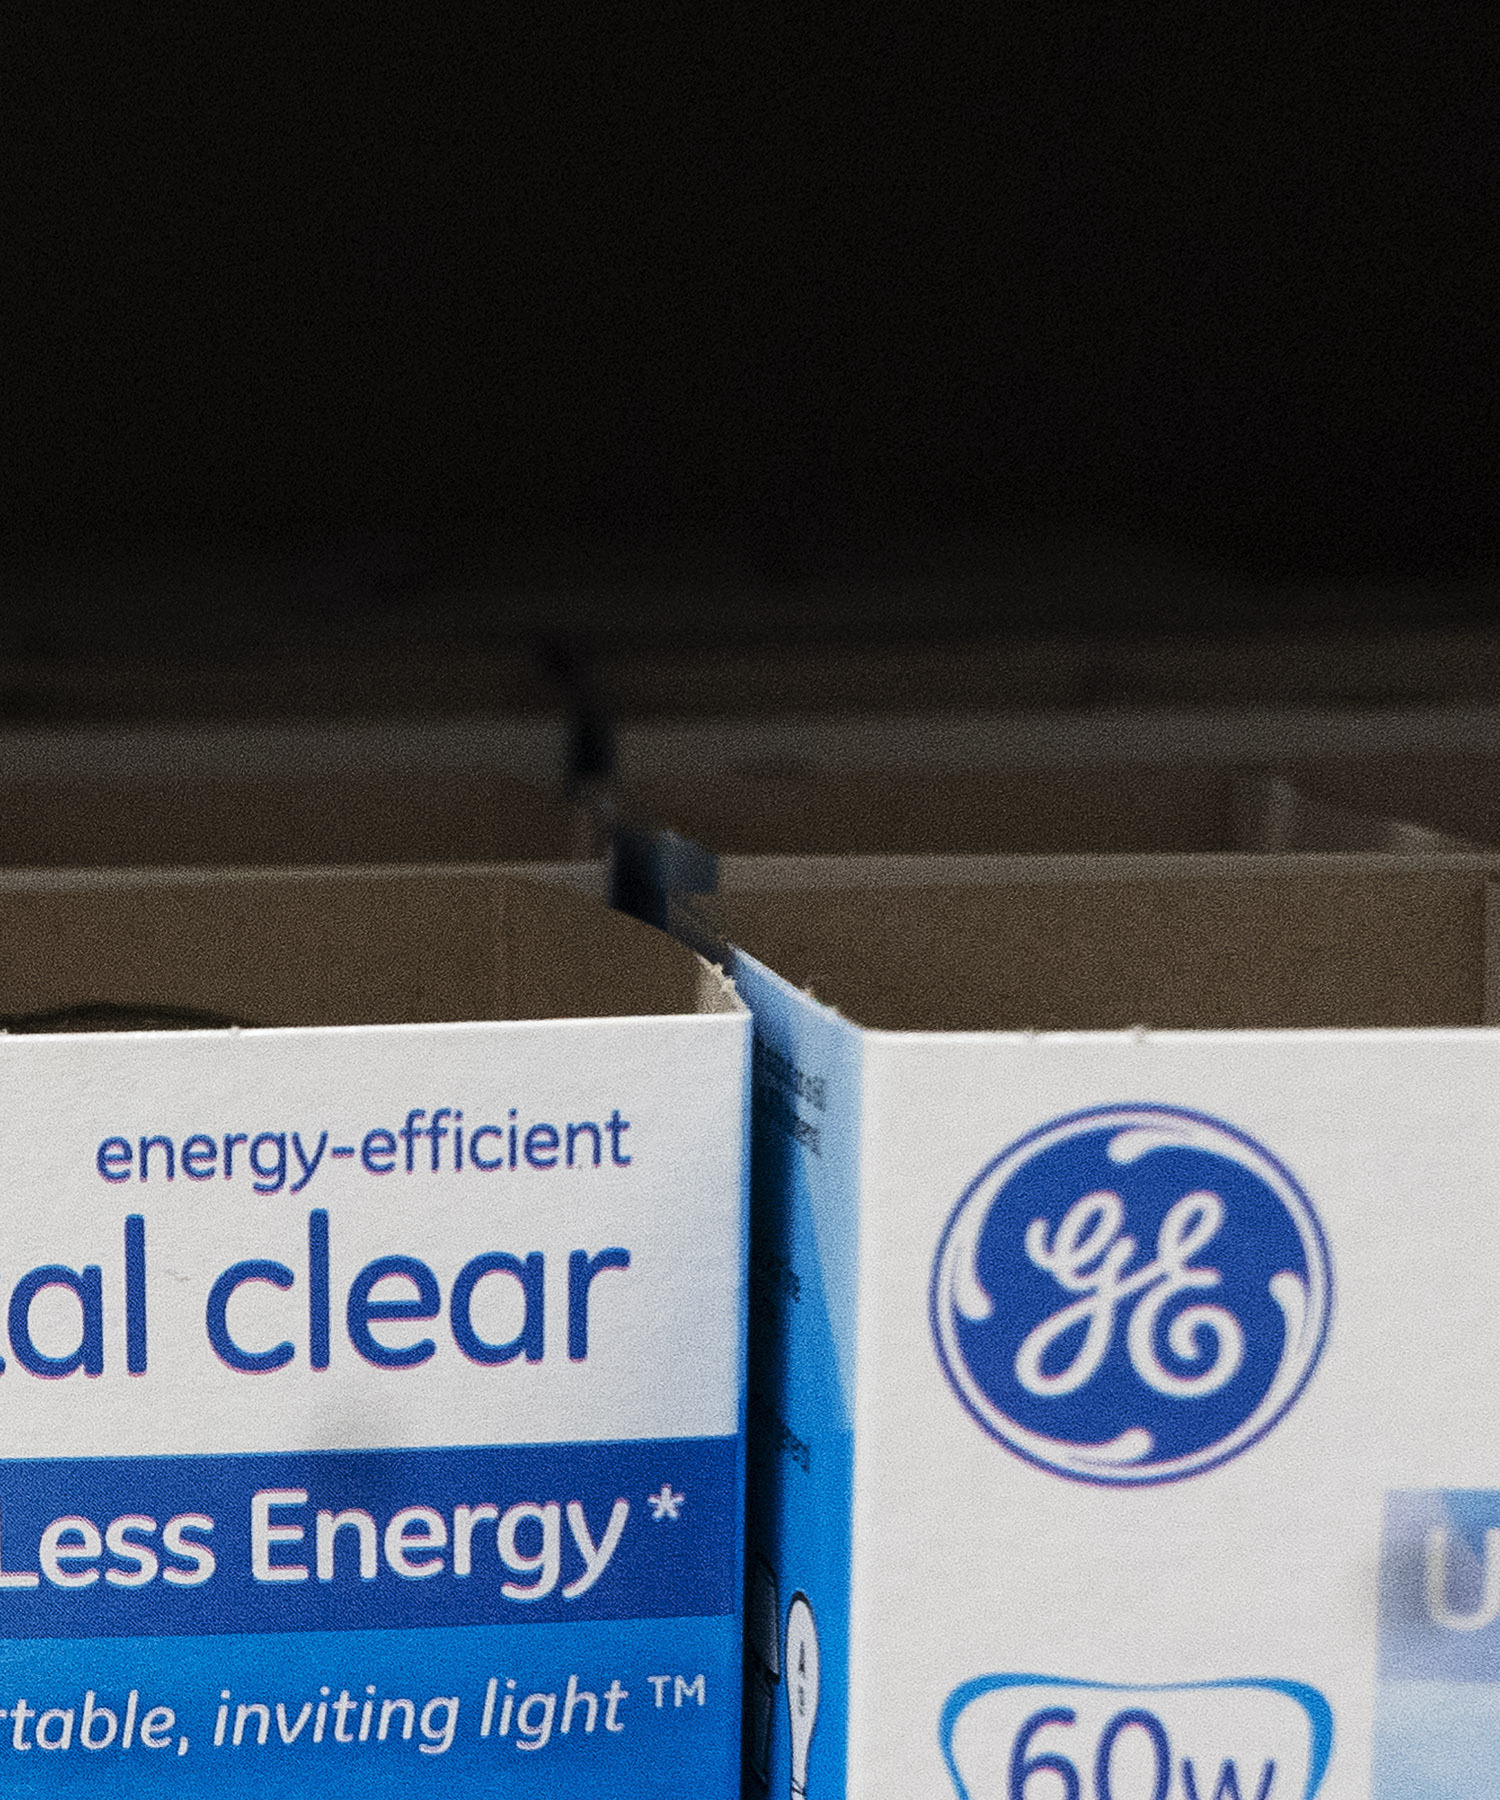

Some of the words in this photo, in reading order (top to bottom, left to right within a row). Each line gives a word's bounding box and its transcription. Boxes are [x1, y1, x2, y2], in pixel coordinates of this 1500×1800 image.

[96, 1108, 632, 1193] energy-efficient
[206, 1210, 630, 1376] clear
[214, 1684, 452, 1753] inviting
